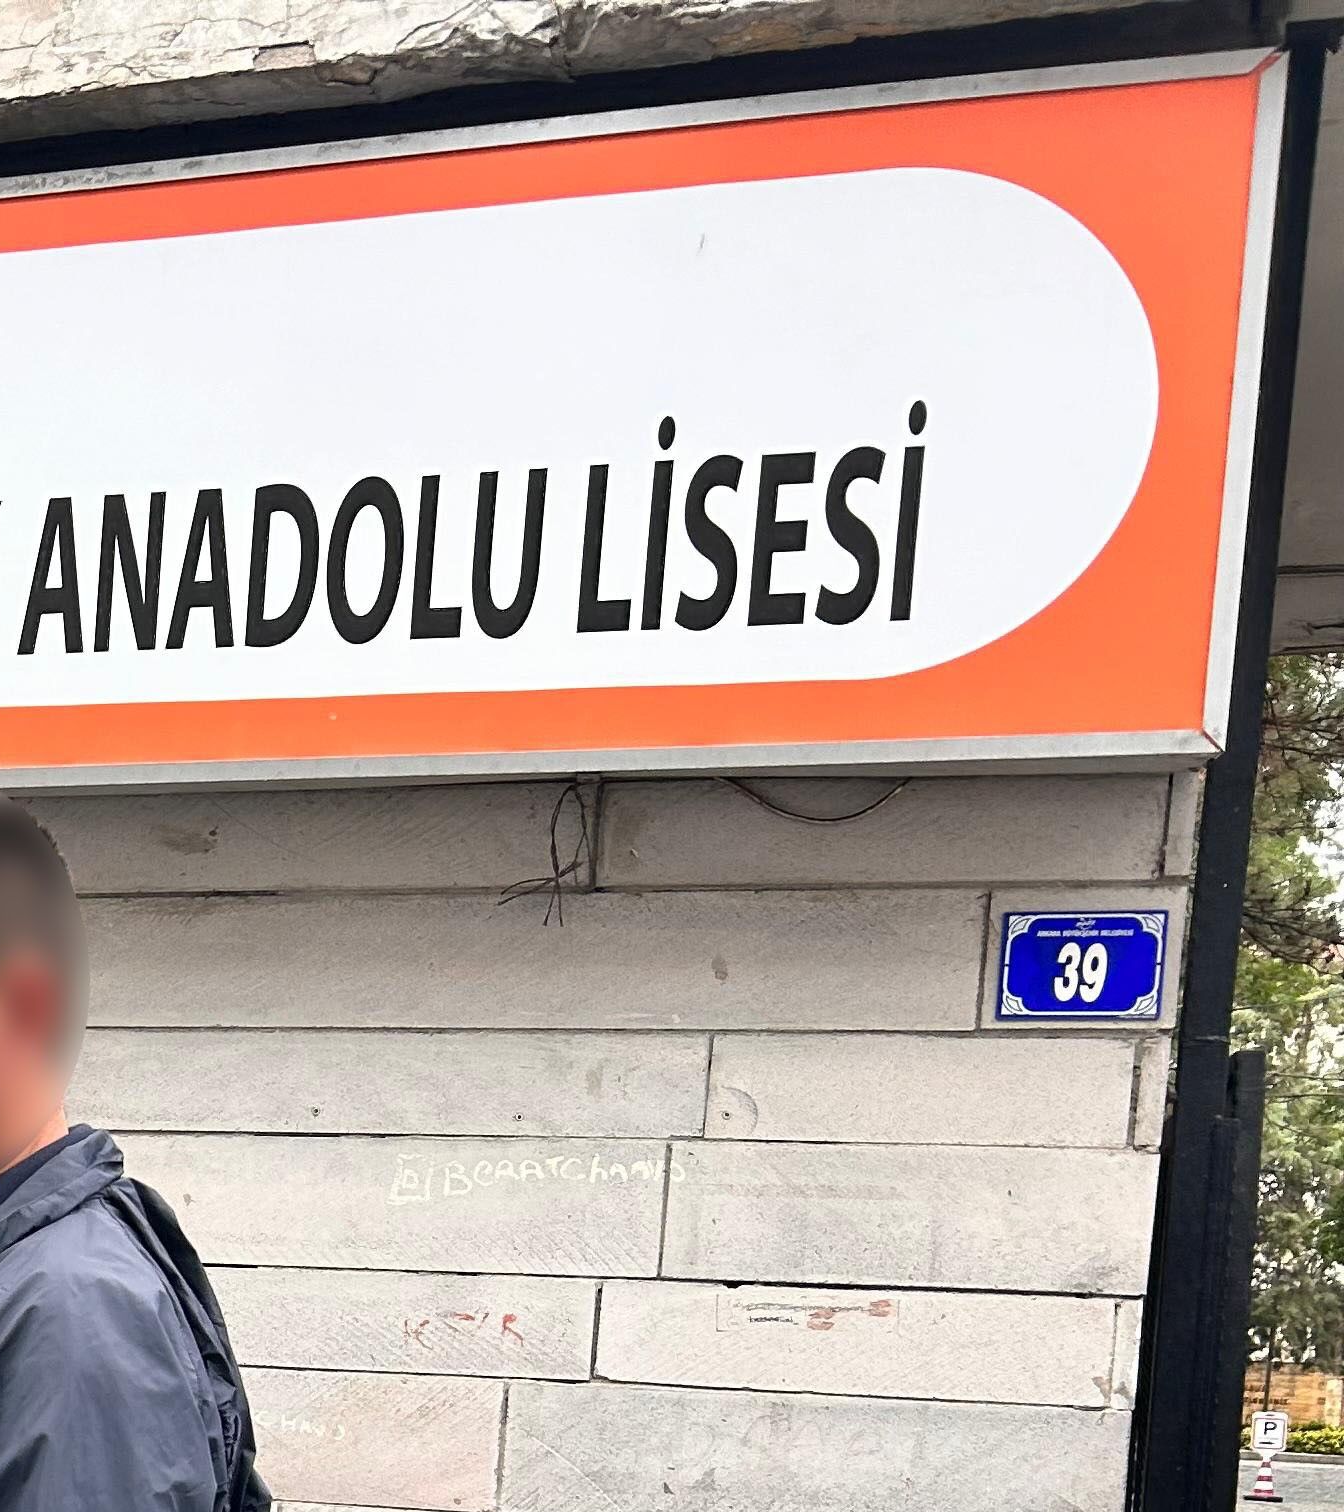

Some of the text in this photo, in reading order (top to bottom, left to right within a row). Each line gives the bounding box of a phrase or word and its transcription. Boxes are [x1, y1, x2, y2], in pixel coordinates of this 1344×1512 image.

[16, 467, 549, 656] ANADOLU
[576, 400, 927, 634] LİSESİ
[1053, 941, 1109, 1003] 39
[1263, 1421, 1278, 1436] P
